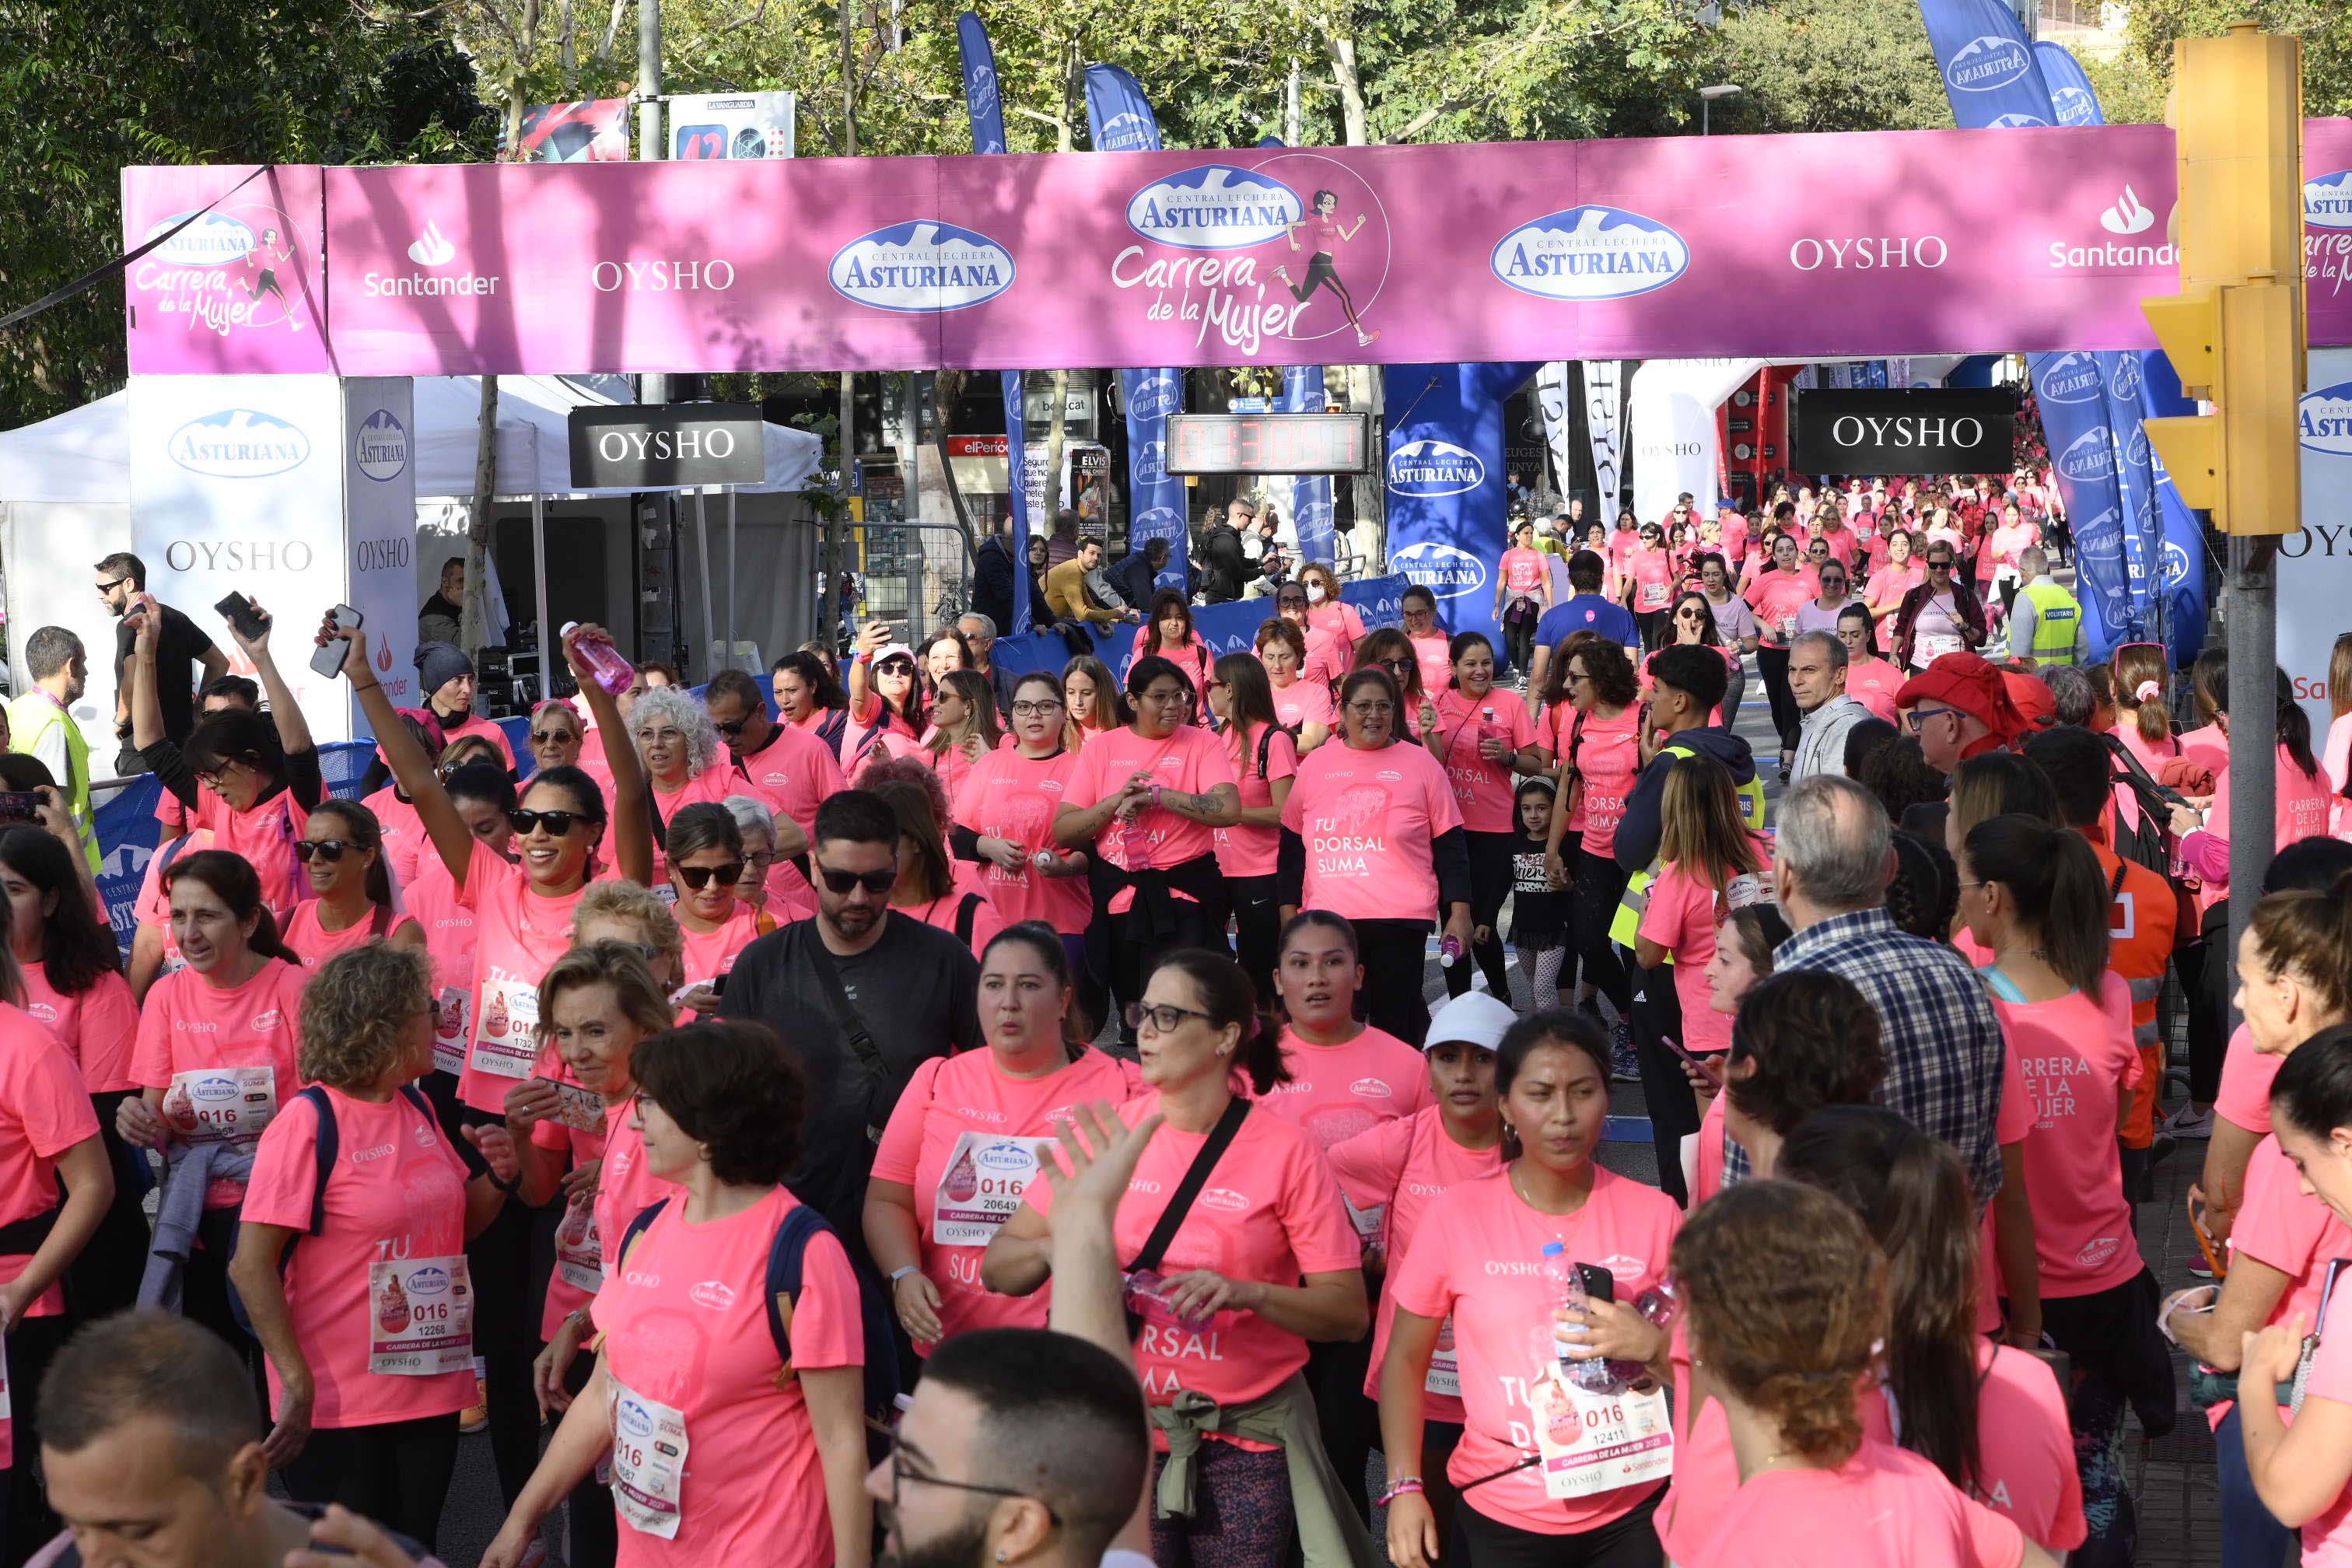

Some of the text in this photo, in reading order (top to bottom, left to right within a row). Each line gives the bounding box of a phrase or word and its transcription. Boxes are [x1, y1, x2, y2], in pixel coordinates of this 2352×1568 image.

[1167, 192, 1285, 204] CENTRAL LECHERA
[1139, 196, 1290, 229] ASTURIANA
[1537, 236, 1668, 249] CENTRAL LECHERA
[872, 250, 994, 261] CENTRAL LECHERA
[1506, 242, 1675, 277] ASTURIANA
[1790, 236, 1948, 271] OYSHO
[592, 259, 734, 292] OYSHO
[842, 254, 1002, 289] ASTURIANA
[1111, 245, 1257, 289] Carrera
[2322, 257, 2336, 278] la
[135, 261, 229, 292] Carrera
[364, 272, 499, 296] Santander
[158, 289, 262, 337] de la Mujer
[1146, 282, 1311, 356] de la Mujer
[1832, 415, 1983, 449] OYSHO
[180, 436, 300, 461] ASTURIANA
[359, 439, 405, 464] ASTURIANA
[600, 428, 734, 463] OYSHO
[1082, 456, 1106, 466] ELVIS
[1390, 463, 1478, 485] ASTURIANA
[165, 540, 313, 572] OYSHO
[358, 536, 409, 572] OYSHO
[1325, 771, 1353, 779] OYSHO
[2289, 797, 2326, 814] CARRERA
[1314, 817, 1336, 832] TU
[2296, 811, 2320, 826] DE LA
[985, 824, 1002, 839] TU
[1314, 835, 1386, 853] DORSAL
[1318, 856, 1367, 873] SUMA
[436, 918, 473, 929] OYSHO
[176, 1020, 217, 1034] OYSHO
[486, 1045, 515, 1055] CARRERA
[481, 1057, 514, 1069] OYSHO
[197, 1087, 236, 1097] ASTURIANA
[2045, 1077, 2073, 1097] LA
[198, 1108, 237, 1124] 016
[958, 1107, 1008, 1124] OYSHO
[352, 1143, 396, 1164] OYSHO
[982, 1153, 1029, 1166] ASTURIANA
[981, 1178, 1024, 1196] 016
[984, 1199, 1017, 1211] 20649
[950, 1213, 985, 1222] CARRERA
[946, 1228, 985, 1238] OYSHO
[374, 1236, 411, 1260] TU
[410, 1279, 447, 1290] ASTURIANA
[414, 1304, 448, 1321] 016
[418, 1324, 446, 1336] 12268
[386, 1342, 421, 1351] CARRERA
[1143, 1327, 1224, 1362] RSAL
[381, 1357, 421, 1367] OYSHO
[1585, 1404, 1624, 1428] 016
[1594, 1429, 1626, 1445] 12411
[617, 1437, 643, 1468] 016
[1561, 1453, 1599, 1467] CARRERA
[1599, 1451, 1610, 1459] DE
[1610, 1447, 1621, 1457] LA
[1561, 1471, 1602, 1488] OYSHO
[628, 1488, 648, 1503] MUJER
